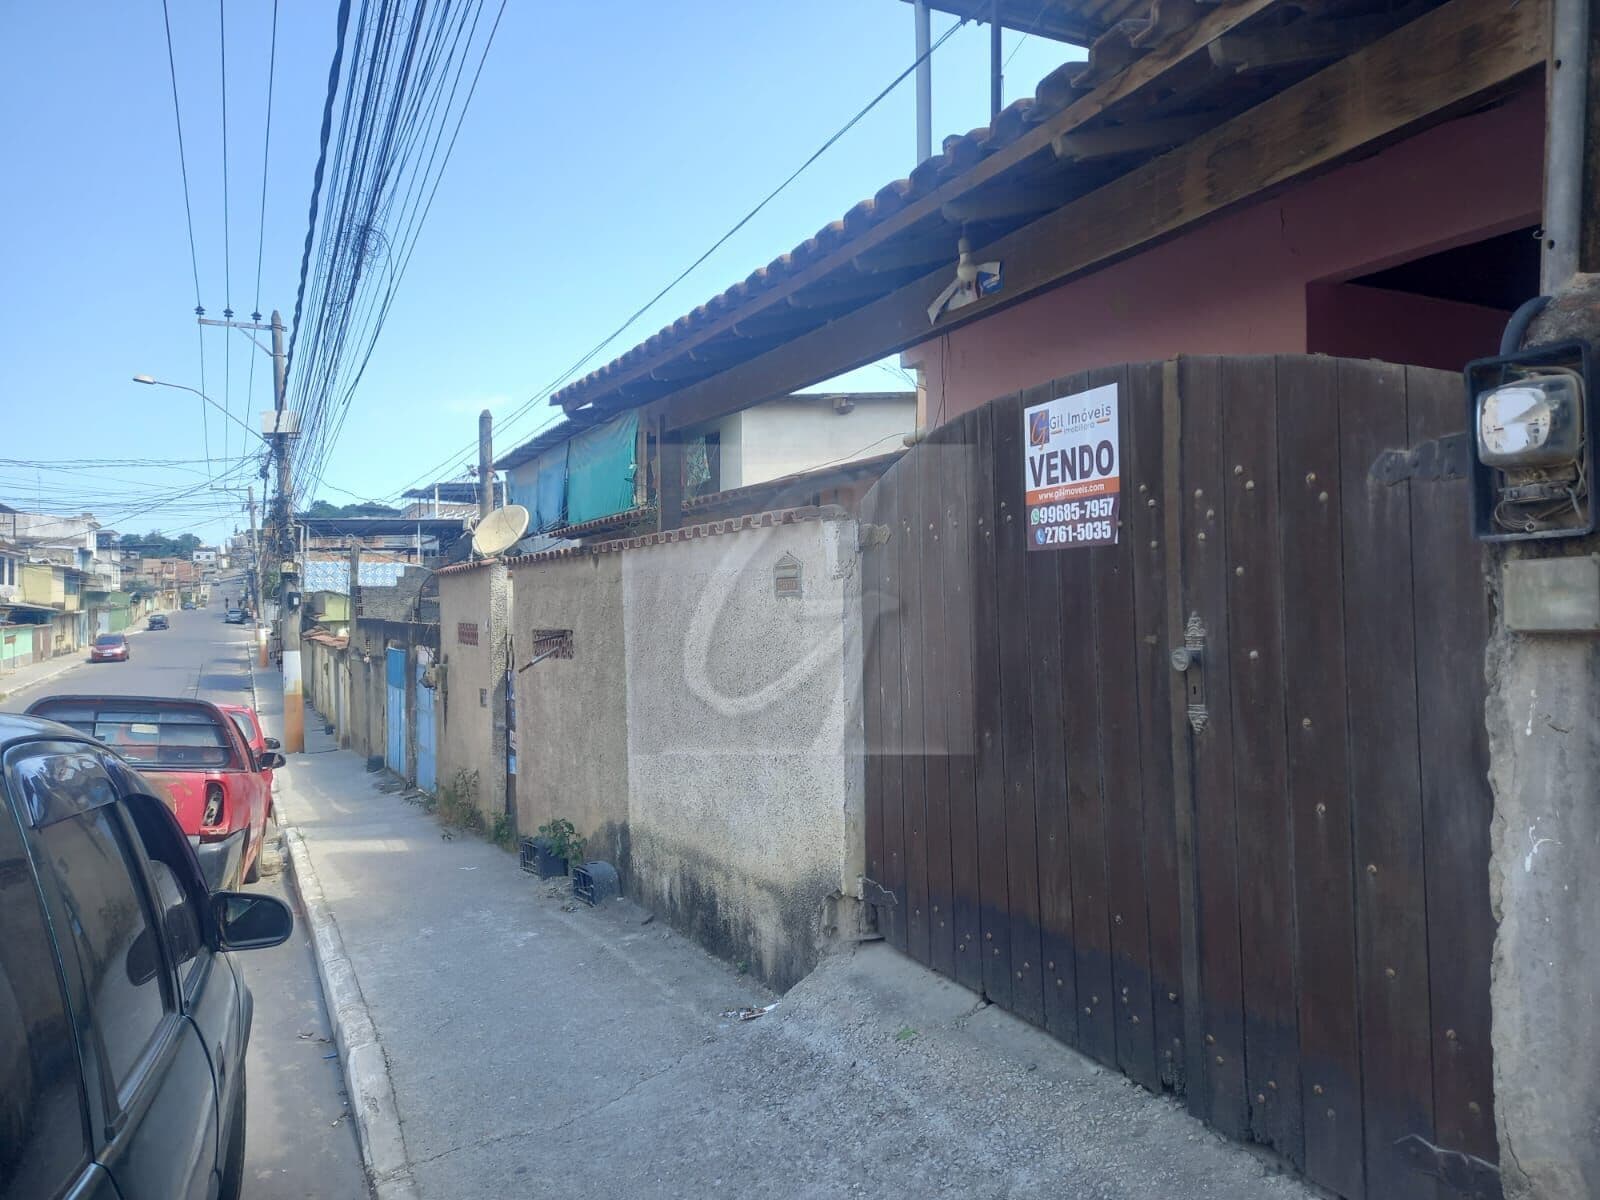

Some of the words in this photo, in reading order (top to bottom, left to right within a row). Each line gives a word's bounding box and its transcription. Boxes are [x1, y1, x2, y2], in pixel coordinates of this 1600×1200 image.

[1050, 414, 1064, 430] Gil
[1067, 404, 1112, 426] Imóveis
[1029, 439, 1114, 488] VENDO
[1039, 497, 1114, 524] 99685-7957
[1044, 521, 1112, 544] 2761-5035
